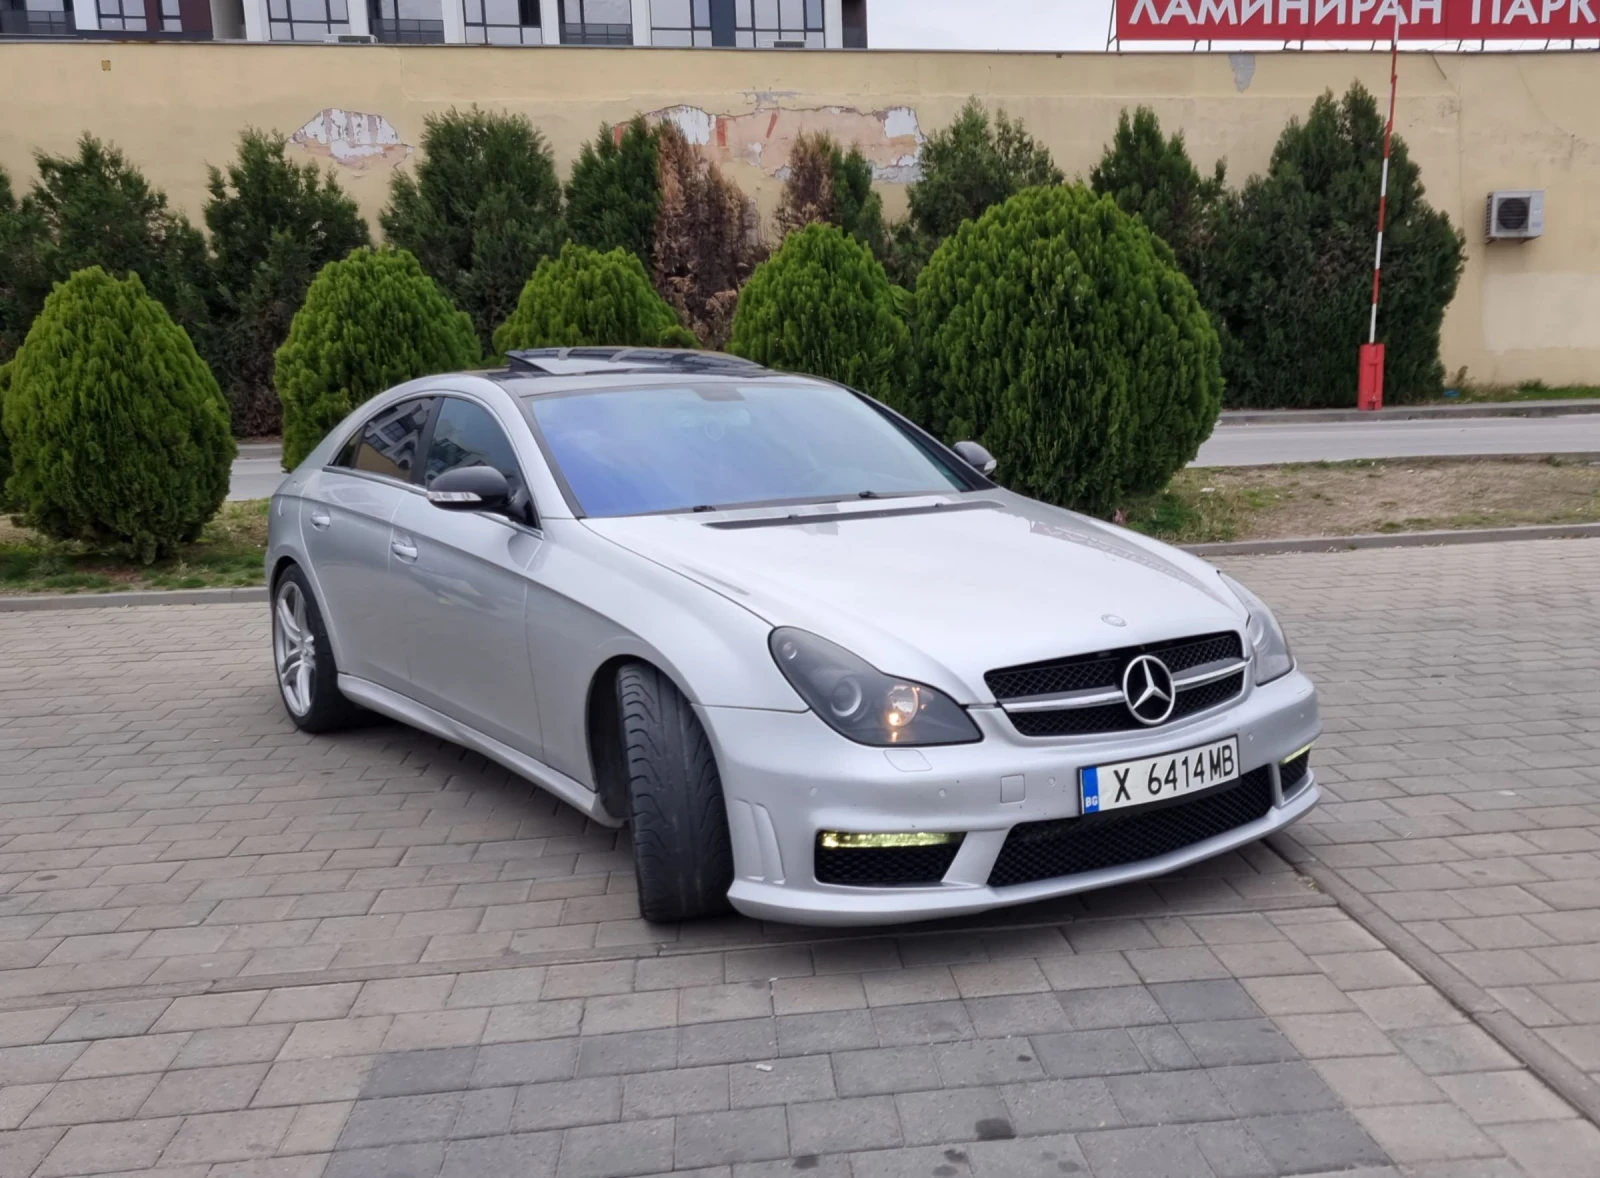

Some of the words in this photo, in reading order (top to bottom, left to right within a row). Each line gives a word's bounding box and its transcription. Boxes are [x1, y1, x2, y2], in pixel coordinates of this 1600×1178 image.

[1128, 0, 1442, 26] ЛАМИНИРАН
[1113, 768, 1131, 802] X
[1085, 796, 1099, 808] BG
